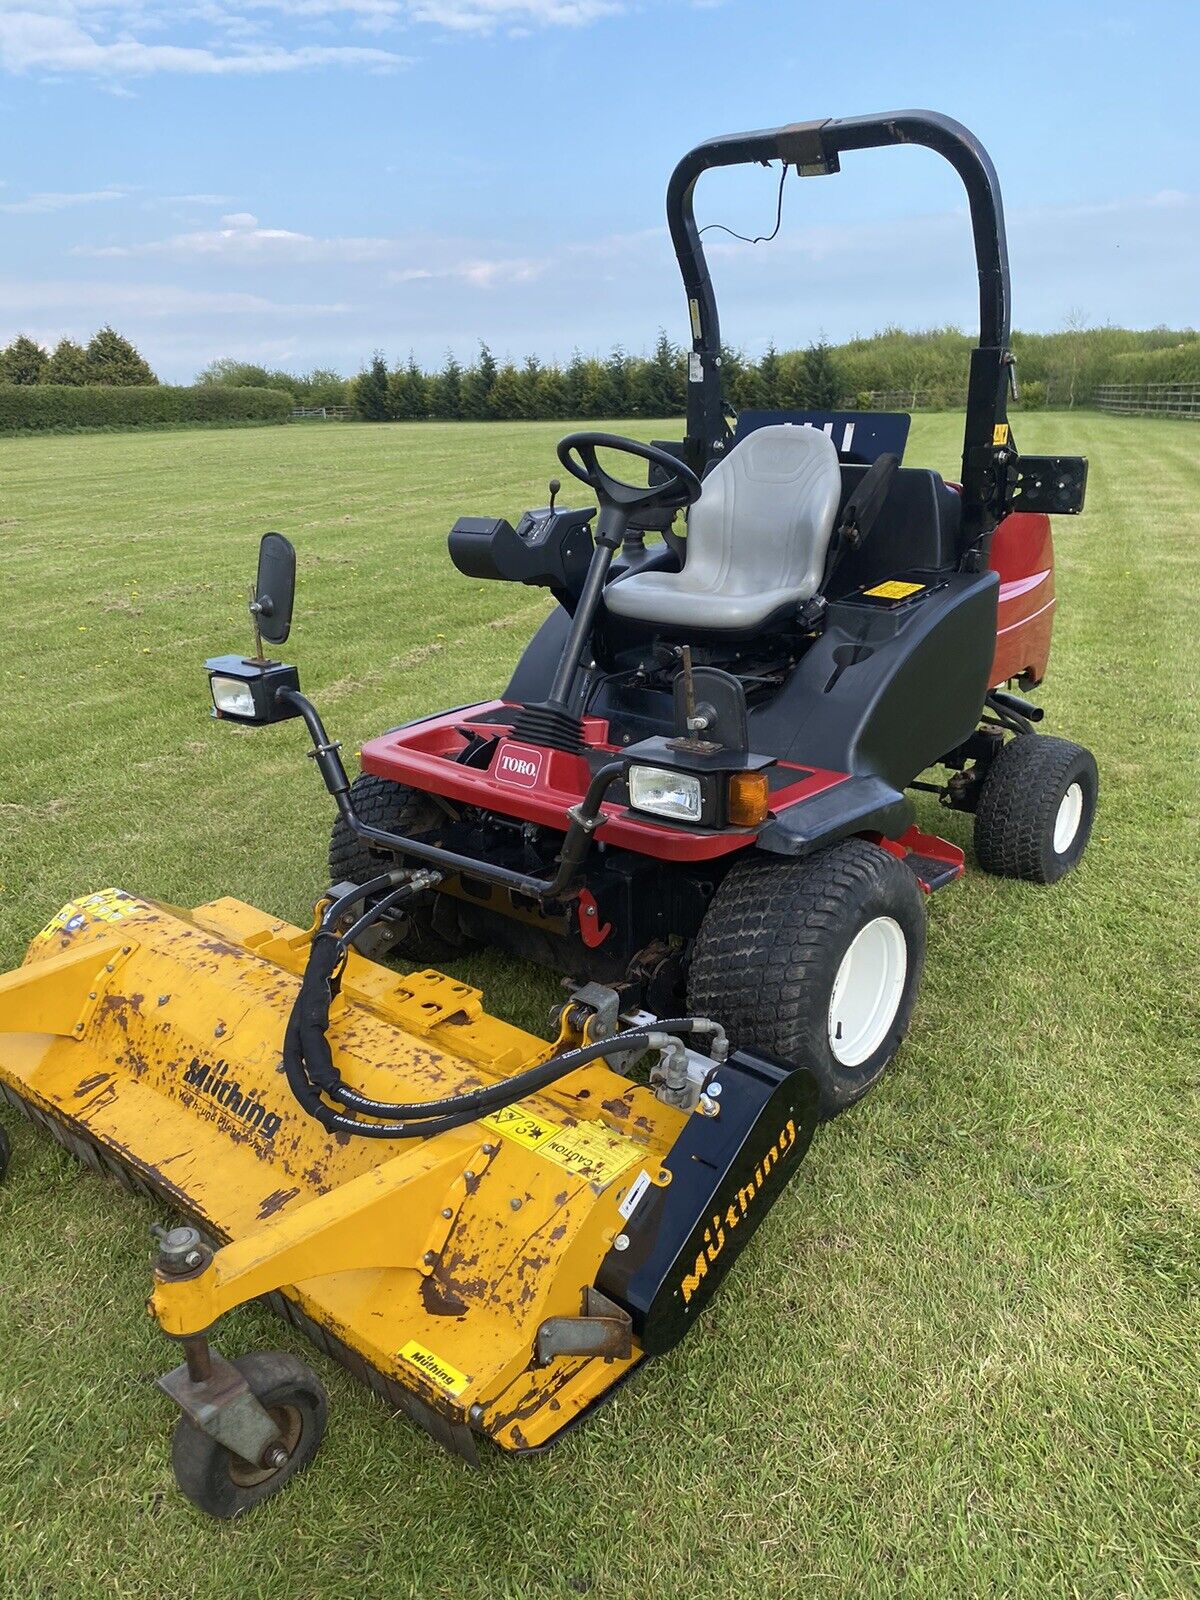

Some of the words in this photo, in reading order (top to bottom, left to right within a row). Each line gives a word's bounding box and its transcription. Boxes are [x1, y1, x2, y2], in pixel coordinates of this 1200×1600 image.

[183, 1056, 283, 1141] Müthing
[548, 1141, 594, 1167] CAUTION
[681, 1119, 797, 1304] Müthing
[411, 1351, 456, 1385] Müthing
